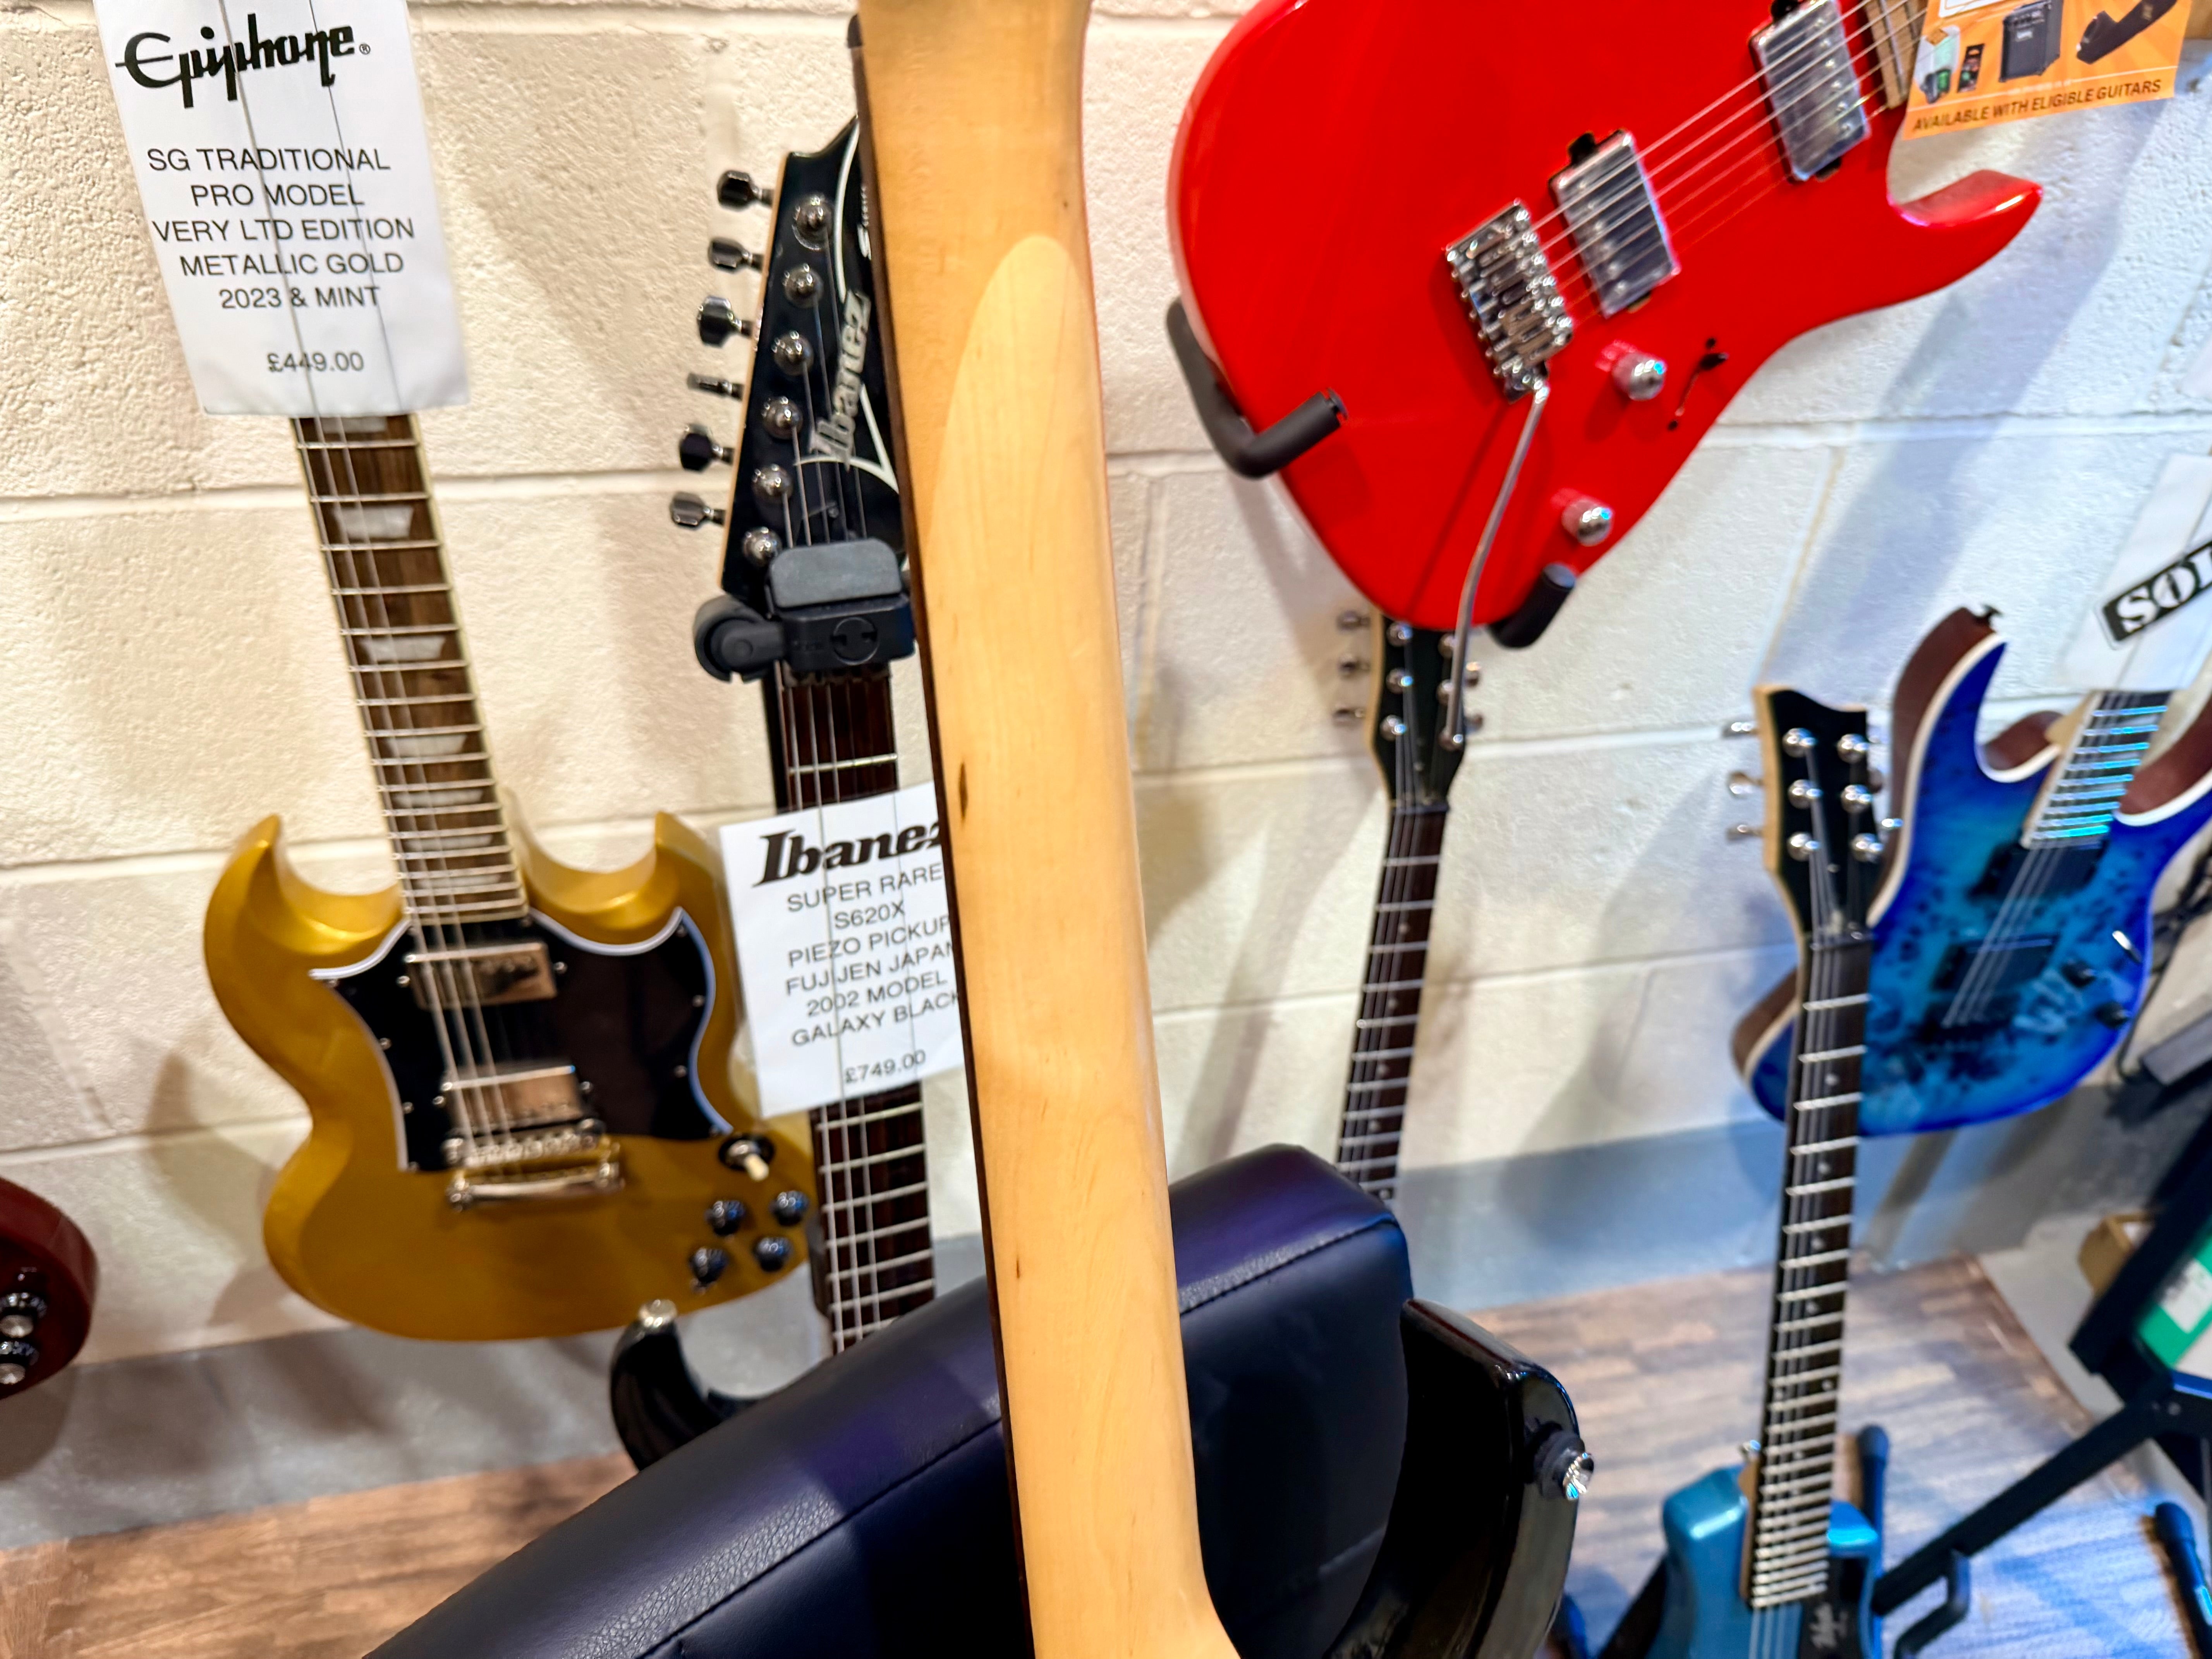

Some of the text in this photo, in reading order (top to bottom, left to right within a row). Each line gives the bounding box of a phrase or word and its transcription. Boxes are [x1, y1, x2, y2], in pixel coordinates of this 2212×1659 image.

[1913, 107, 1989, 132] AVAILABLE
[1992, 99, 2028, 117] WITH
[2032, 88, 2093, 113] ELIGIBLE
[2097, 79, 2161, 101] GUITARS
[148, 148, 391, 172] SG TRADITIONAL
[191, 184, 364, 206] PRO MODEL
[152, 218, 415, 242] VERY LTD EDITION
[180, 253, 404, 276] METALLIC GOLD
[220, 286, 380, 309] 2023 & MINT
[268, 352, 364, 372] £449.00
[808, 289, 871, 472] Ibanez
[788, 863, 943, 912] SUPER RARE
[835, 900, 905, 929] S620X
[789, 938, 860, 967] PIEZO
[807, 971, 947, 1017] 2002 MODEL
[792, 1011, 886, 1046] GALAXY
[845, 1049, 925, 1084] £749.00
